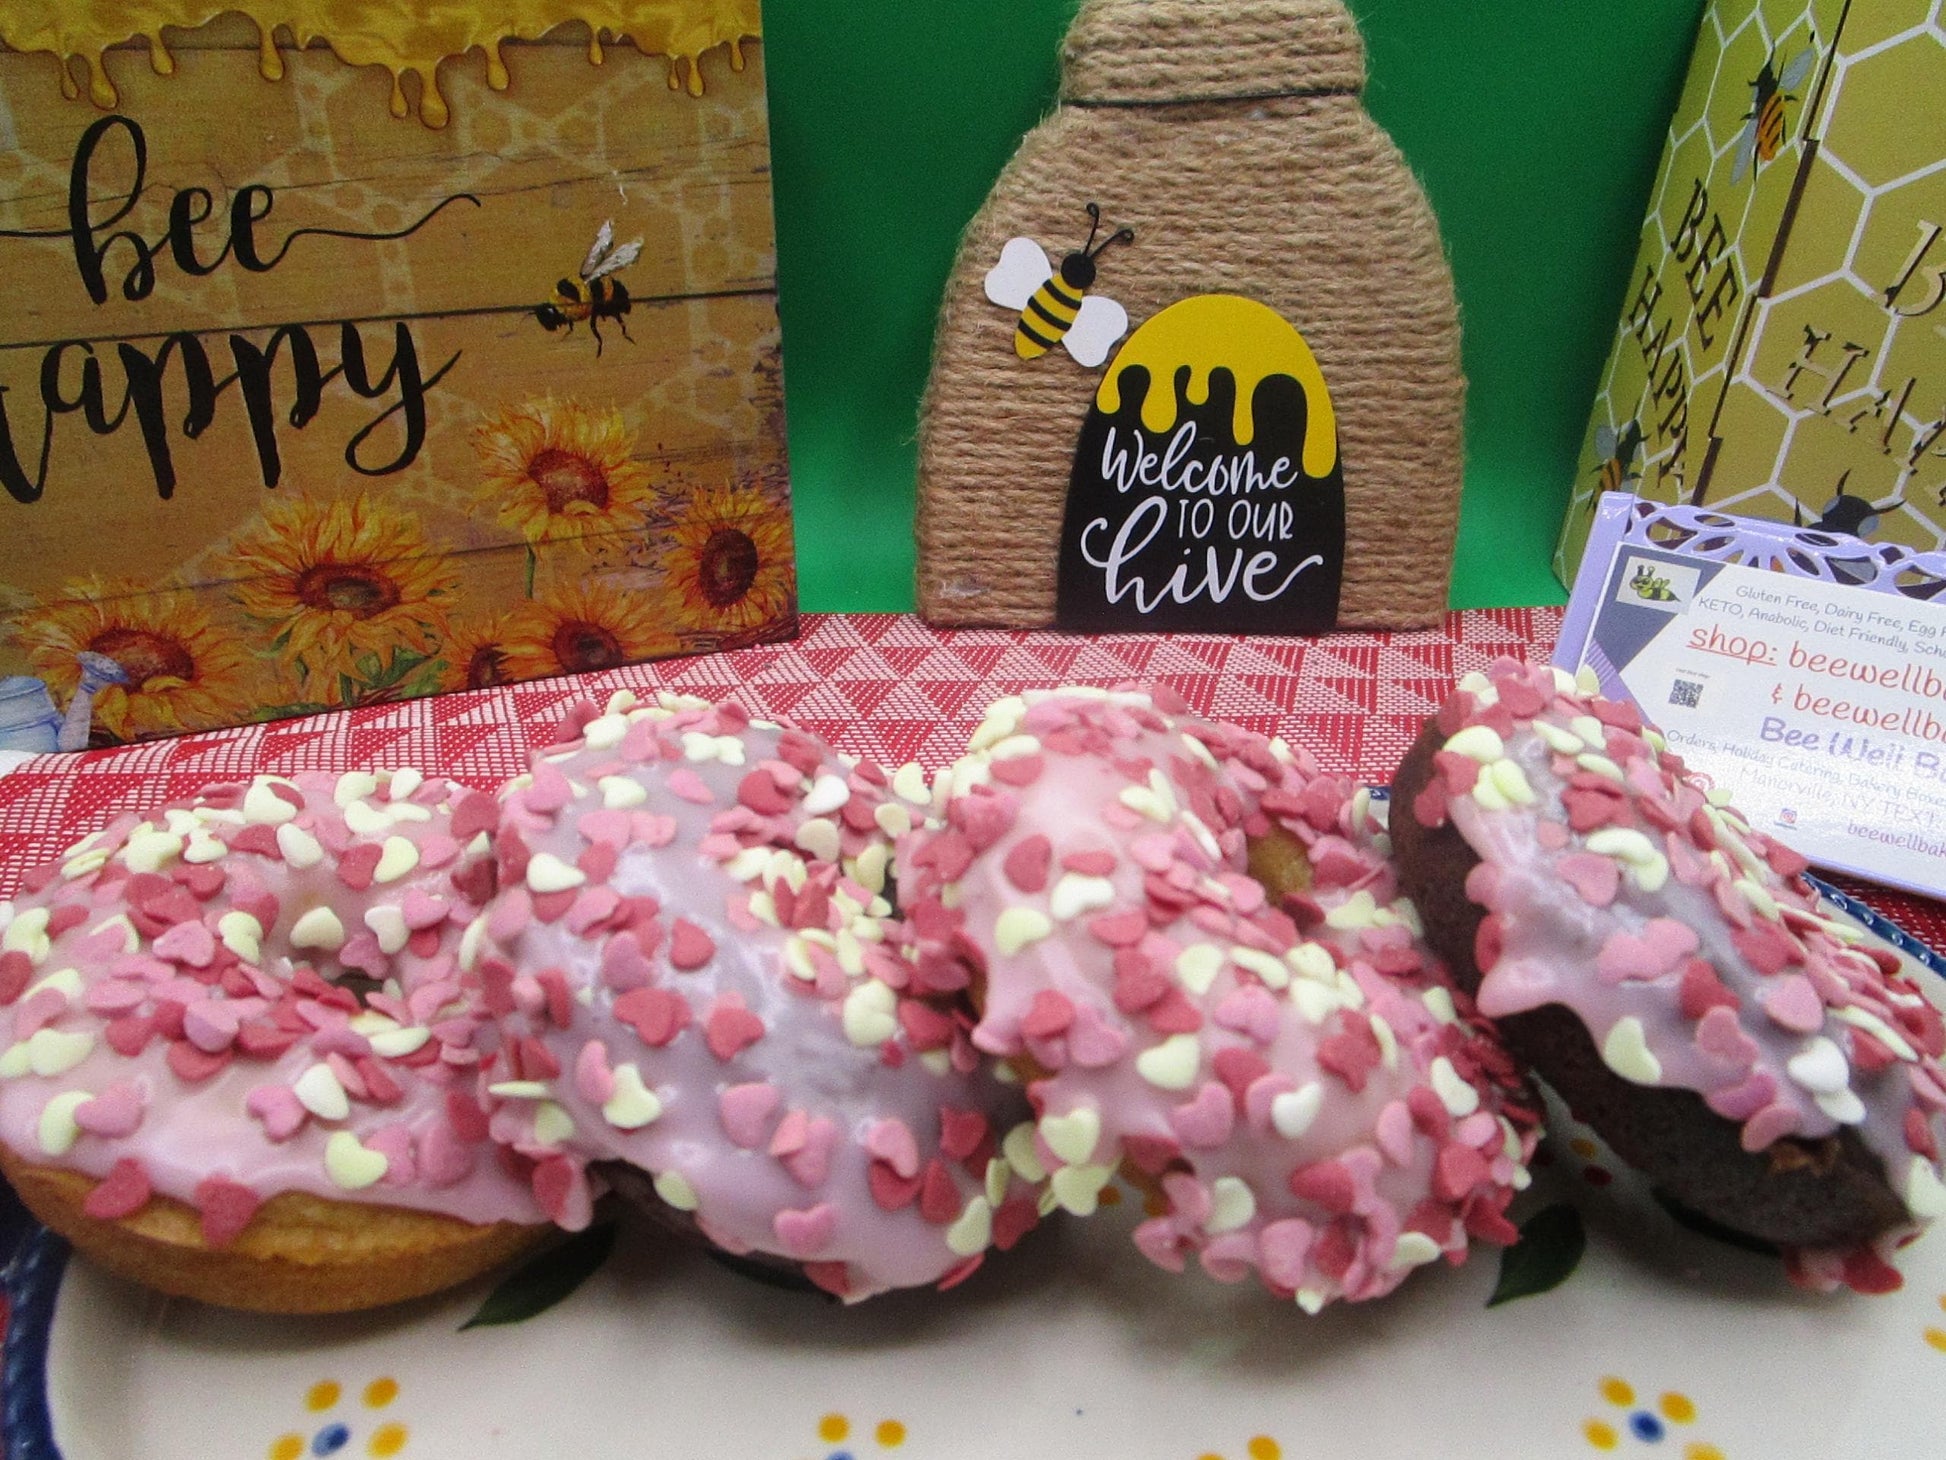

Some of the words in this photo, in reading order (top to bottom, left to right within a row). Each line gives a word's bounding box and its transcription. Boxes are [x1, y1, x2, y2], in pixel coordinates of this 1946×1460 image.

[0, 115, 480, 304] bee
[1670, 178, 1738, 351] BEE
[1102, 421, 1298, 495] Welcome
[1178, 499, 1214, 538] TO
[1228, 499, 1293, 541] OUR
[1080, 496, 1324, 613] hive
[1698, 597, 1744, 618] KETO,
[1748, 608, 1809, 633] Anabolic,
[1814, 620, 1845, 636] Diet
[1848, 627, 1909, 654] Friendly,
[1735, 585, 1782, 604] Gluten
[1785, 595, 1820, 615] Free,
[1825, 603, 1863, 623] Dairy
[1867, 611, 1904, 631] Free,
[1908, 620, 1937, 639] Egg
[1687, 623, 1777, 666] shop:
[1771, 683, 1783, 704] &
[1760, 716, 1820, 750] Bee
